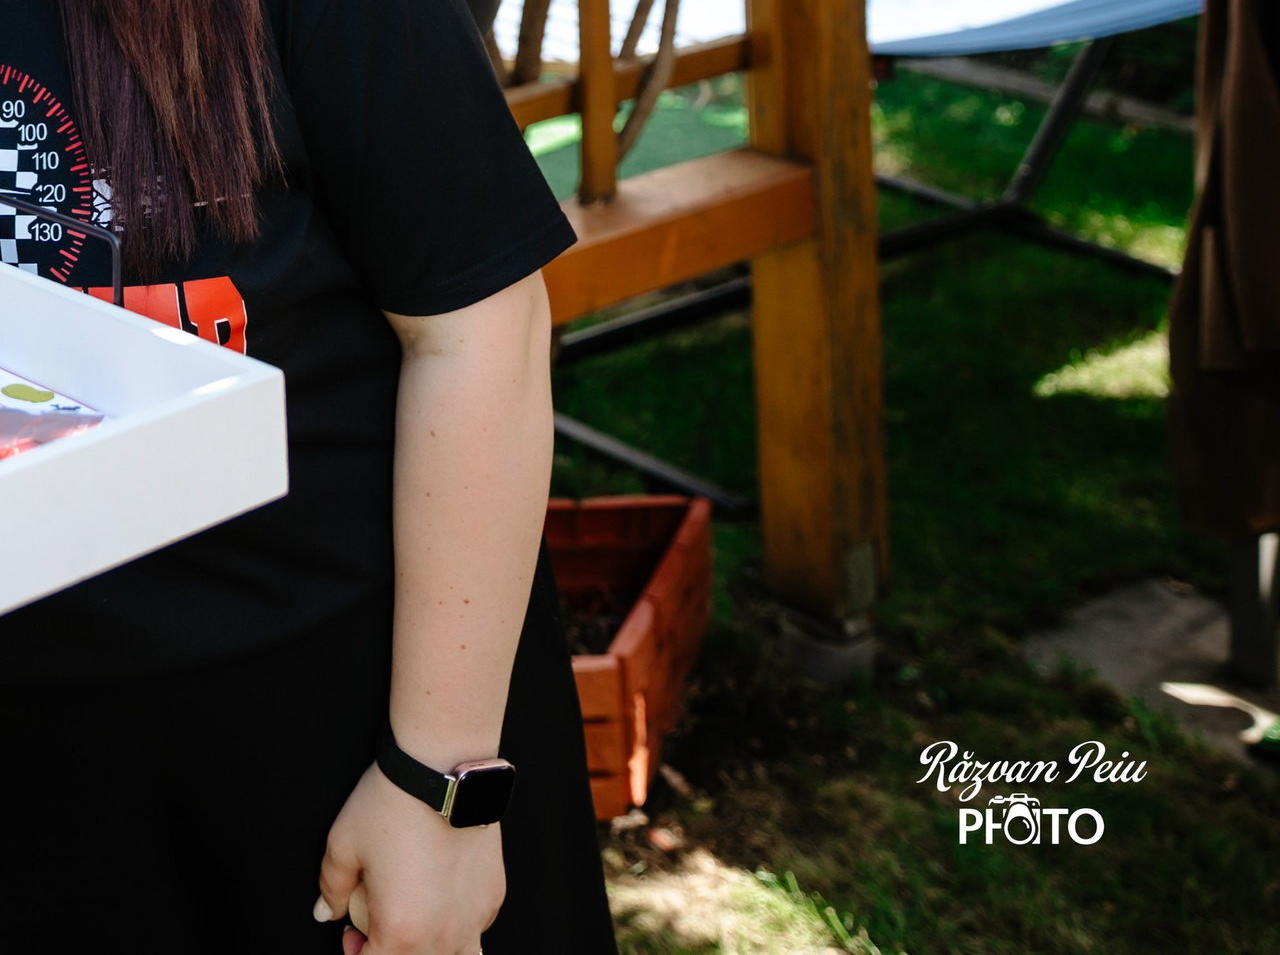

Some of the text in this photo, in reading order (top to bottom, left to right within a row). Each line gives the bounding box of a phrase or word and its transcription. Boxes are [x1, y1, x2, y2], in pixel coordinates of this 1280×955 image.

[2, 99, 26, 119] 90
[17, 122, 48, 142] 100
[31, 151, 60, 171] 110
[35, 184, 66, 203] 120
[30, 222, 63, 242] 130
